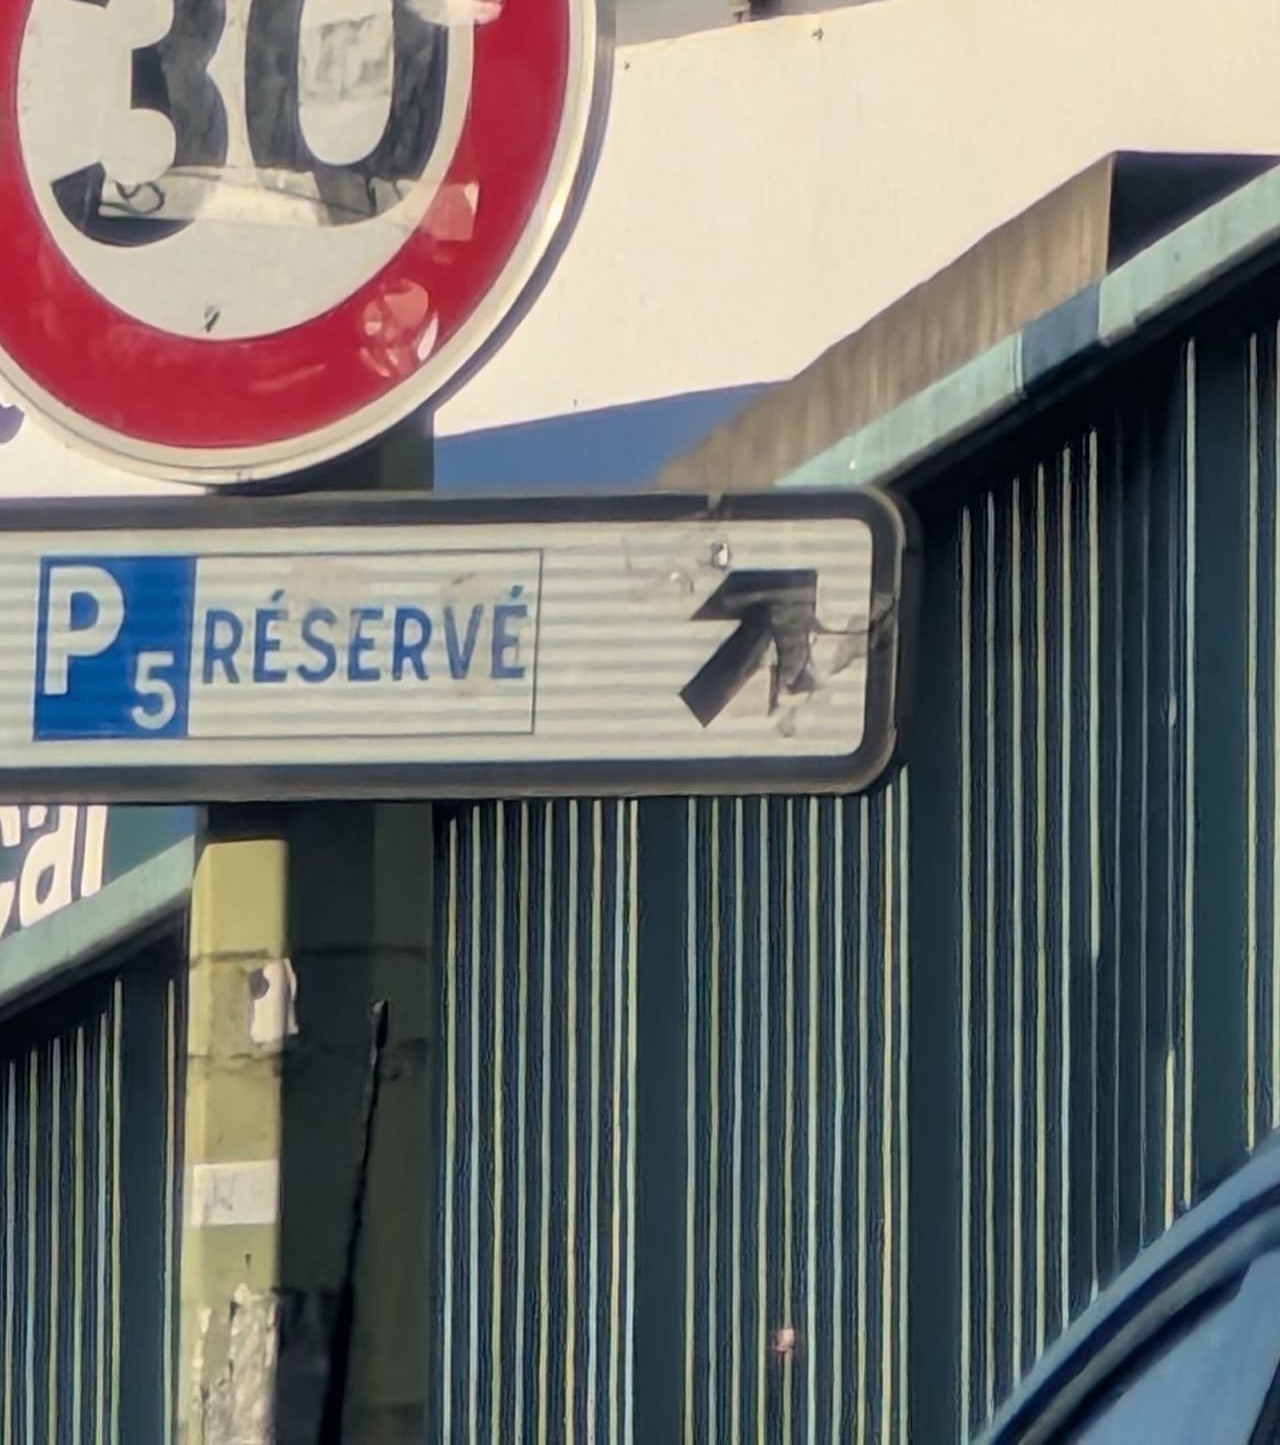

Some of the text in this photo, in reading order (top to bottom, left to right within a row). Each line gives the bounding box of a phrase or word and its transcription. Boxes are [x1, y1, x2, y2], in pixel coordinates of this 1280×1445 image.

[42, 564, 529, 730] P 5 RÉSERVÉ
